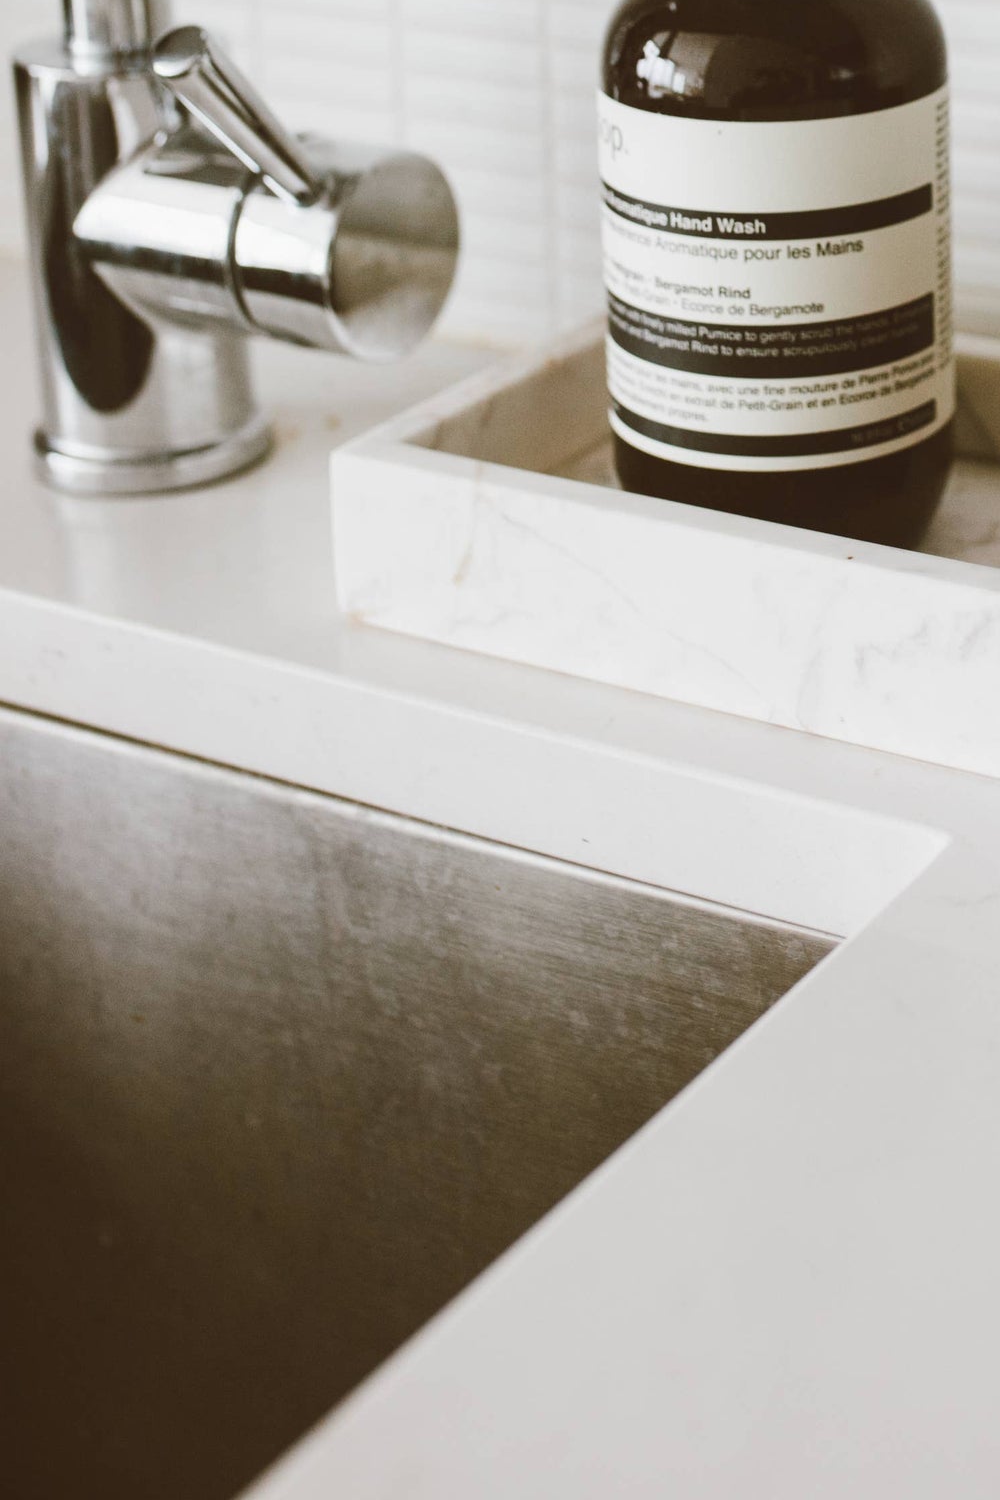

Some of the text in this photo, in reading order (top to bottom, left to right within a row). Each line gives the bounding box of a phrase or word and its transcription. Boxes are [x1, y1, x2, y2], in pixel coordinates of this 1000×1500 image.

[670, 209, 712, 232] Hand
[716, 217, 766, 234] Wash
[744, 247, 781, 261] pour
[787, 244, 811, 258] les
[816, 238, 863, 257] Mains
[655, 278, 750, 299] Bergamot Rind
[681, 299, 723, 315] Ecorce
[728, 304, 745, 315] de
[750, 301, 824, 318] Bergamote
[698, 326, 741, 341] Pumice
[745, 330, 757, 341] to
[759, 329, 797, 346] gently
[692, 340, 718, 354] Rind
[721, 343, 733, 355] to
[736, 344, 780, 357] ensure
[742, 385, 764, 396] une
[768, 382, 786, 396] fine
[789, 381, 839, 394] mouture
[843, 375, 856, 389] de
[738, 399, 803, 411] Petit-Grain
[806, 397, 818, 408] et
[822, 397, 836, 407] en
